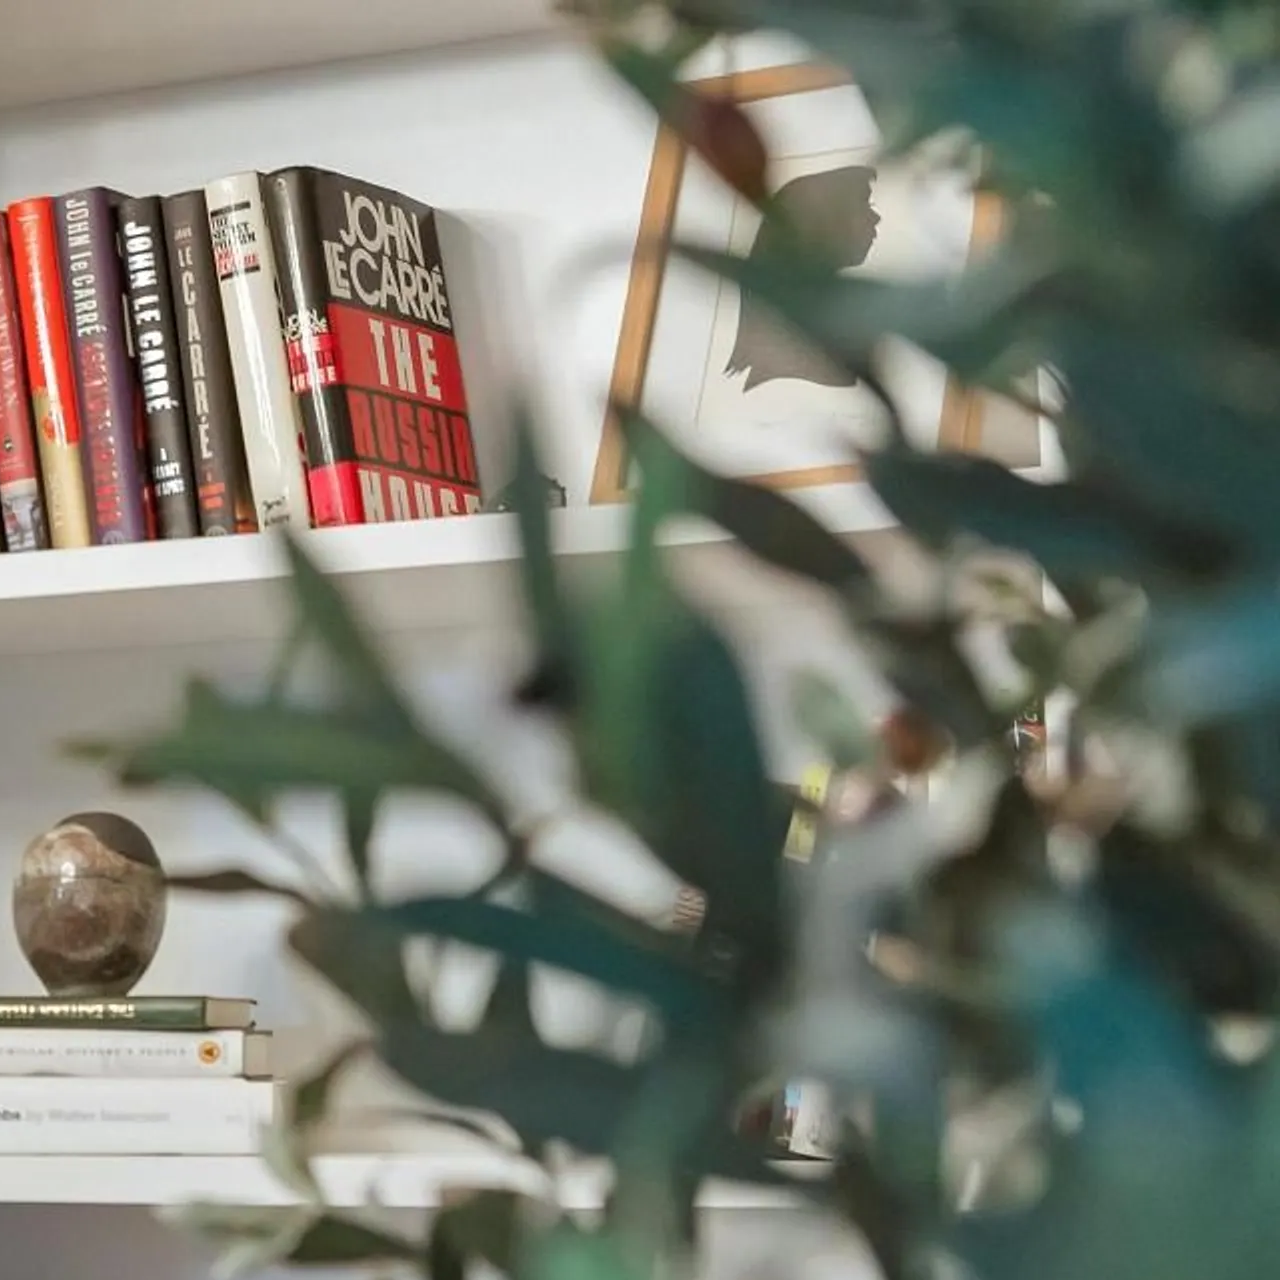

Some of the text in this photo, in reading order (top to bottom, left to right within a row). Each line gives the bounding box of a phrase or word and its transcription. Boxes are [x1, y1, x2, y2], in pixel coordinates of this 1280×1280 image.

[65, 199, 107, 337] JOHN le CARRÉ
[340, 192, 424, 266] JOHN
[124, 221, 179, 414] JOHN LE CARRÉ
[323, 240, 351, 299] LE
[349, 263, 451, 328] CARRÉ
[369, 317, 441, 400] THE
[346, 391, 478, 484] RUSSIA
